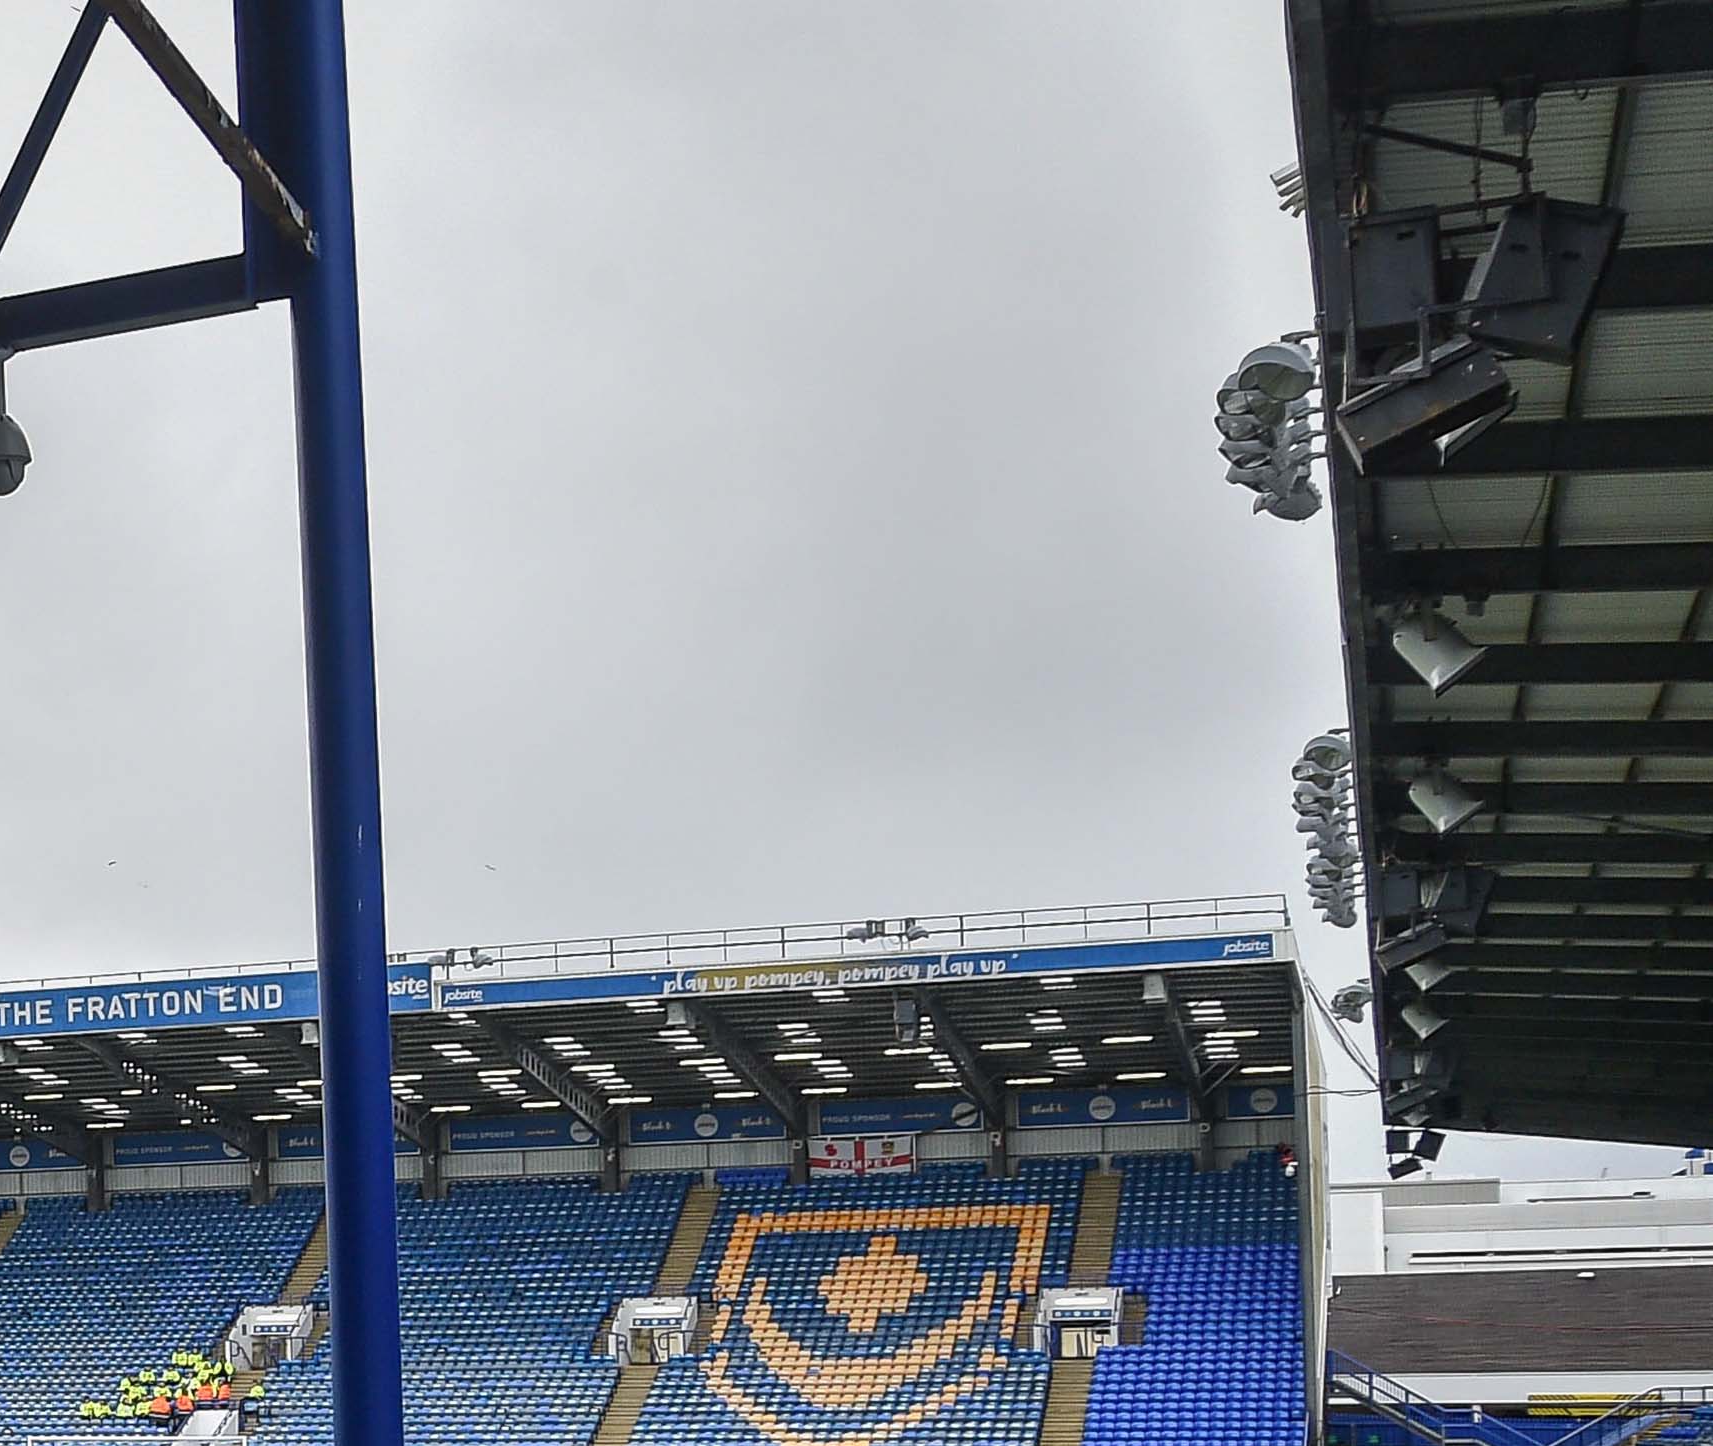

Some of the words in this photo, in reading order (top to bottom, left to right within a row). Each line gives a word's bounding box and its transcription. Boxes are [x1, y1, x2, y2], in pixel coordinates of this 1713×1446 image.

[1223, 939, 1270, 957] jobsite
[663, 972, 708, 995] play
[714, 975, 737, 990] up
[744, 970, 831, 991] pompey,
[837, 962, 920, 986] pompey
[926, 955, 974, 979] play
[980, 958, 1007, 975] up
[68, 989, 203, 1023] FRATTON
[219, 984, 282, 1013] END
[443, 988, 483, 1004] jobsite
[829, 1158, 895, 1169] POMPEY
